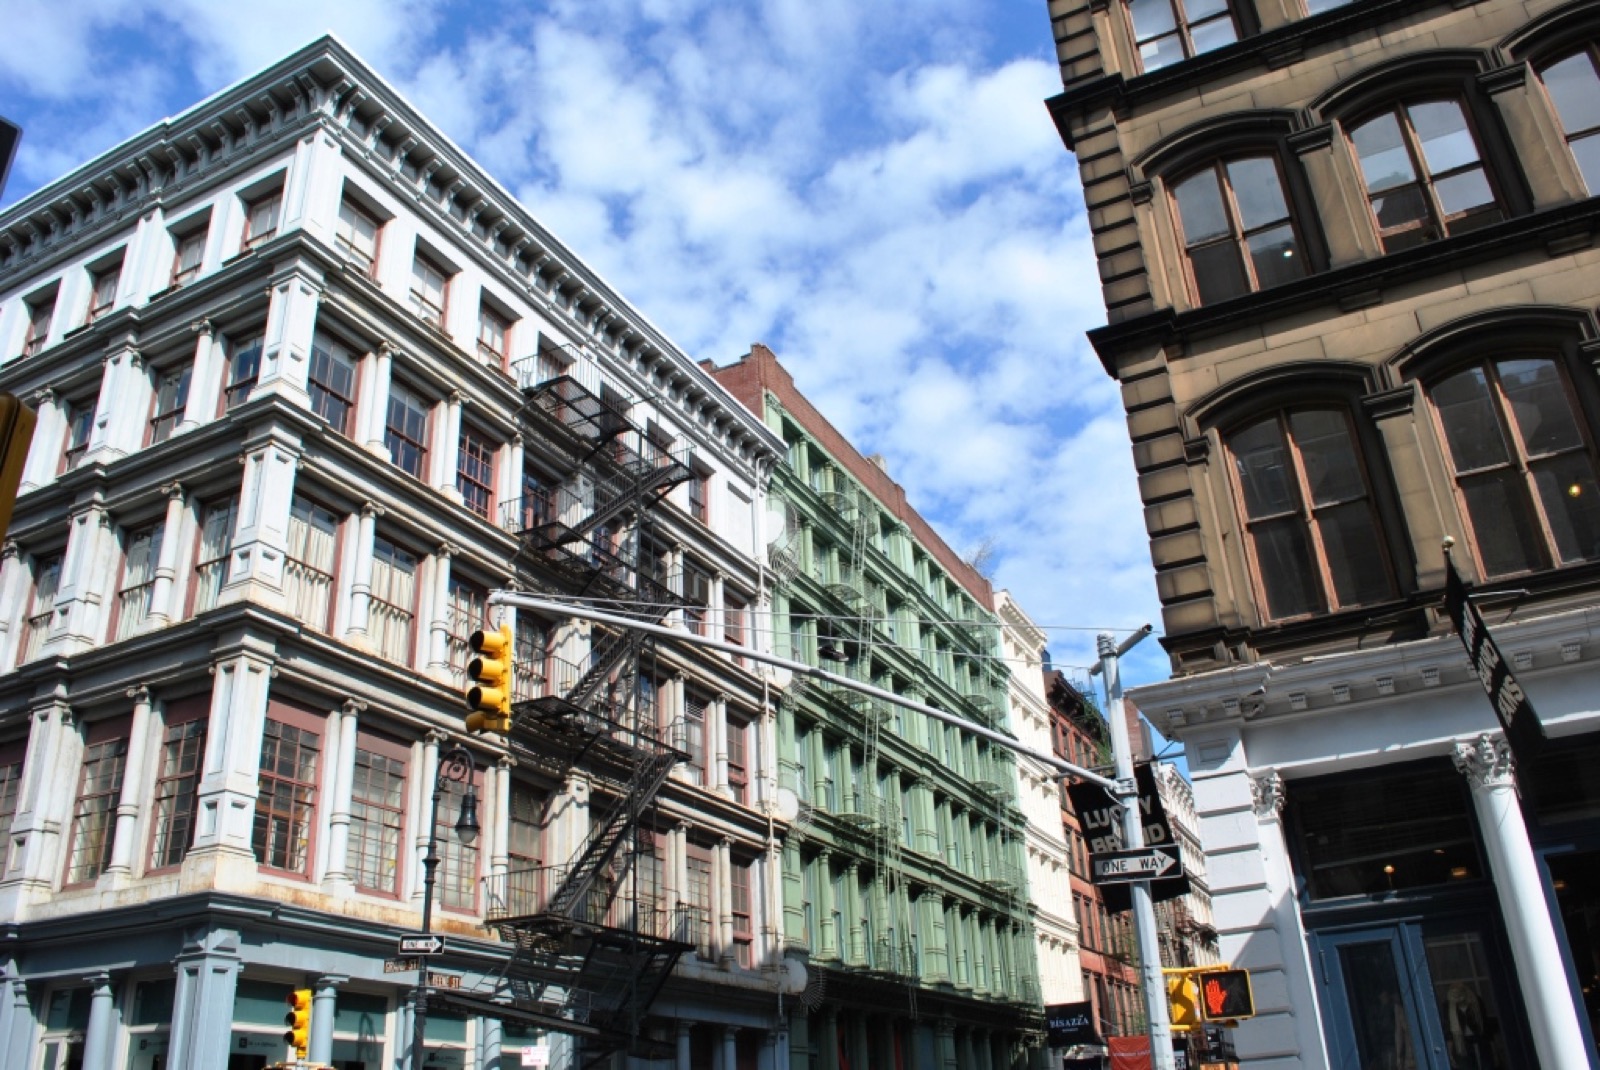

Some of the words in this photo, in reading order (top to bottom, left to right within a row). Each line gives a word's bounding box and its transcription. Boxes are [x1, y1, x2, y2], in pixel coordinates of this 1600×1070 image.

[1498, 674, 1524, 728] EANS
[1083, 795, 1152, 829] LUCY
[1102, 860, 1129, 873] ONE
[1139, 856, 1166, 869] WAY
[406, 940, 418, 948] ONE
